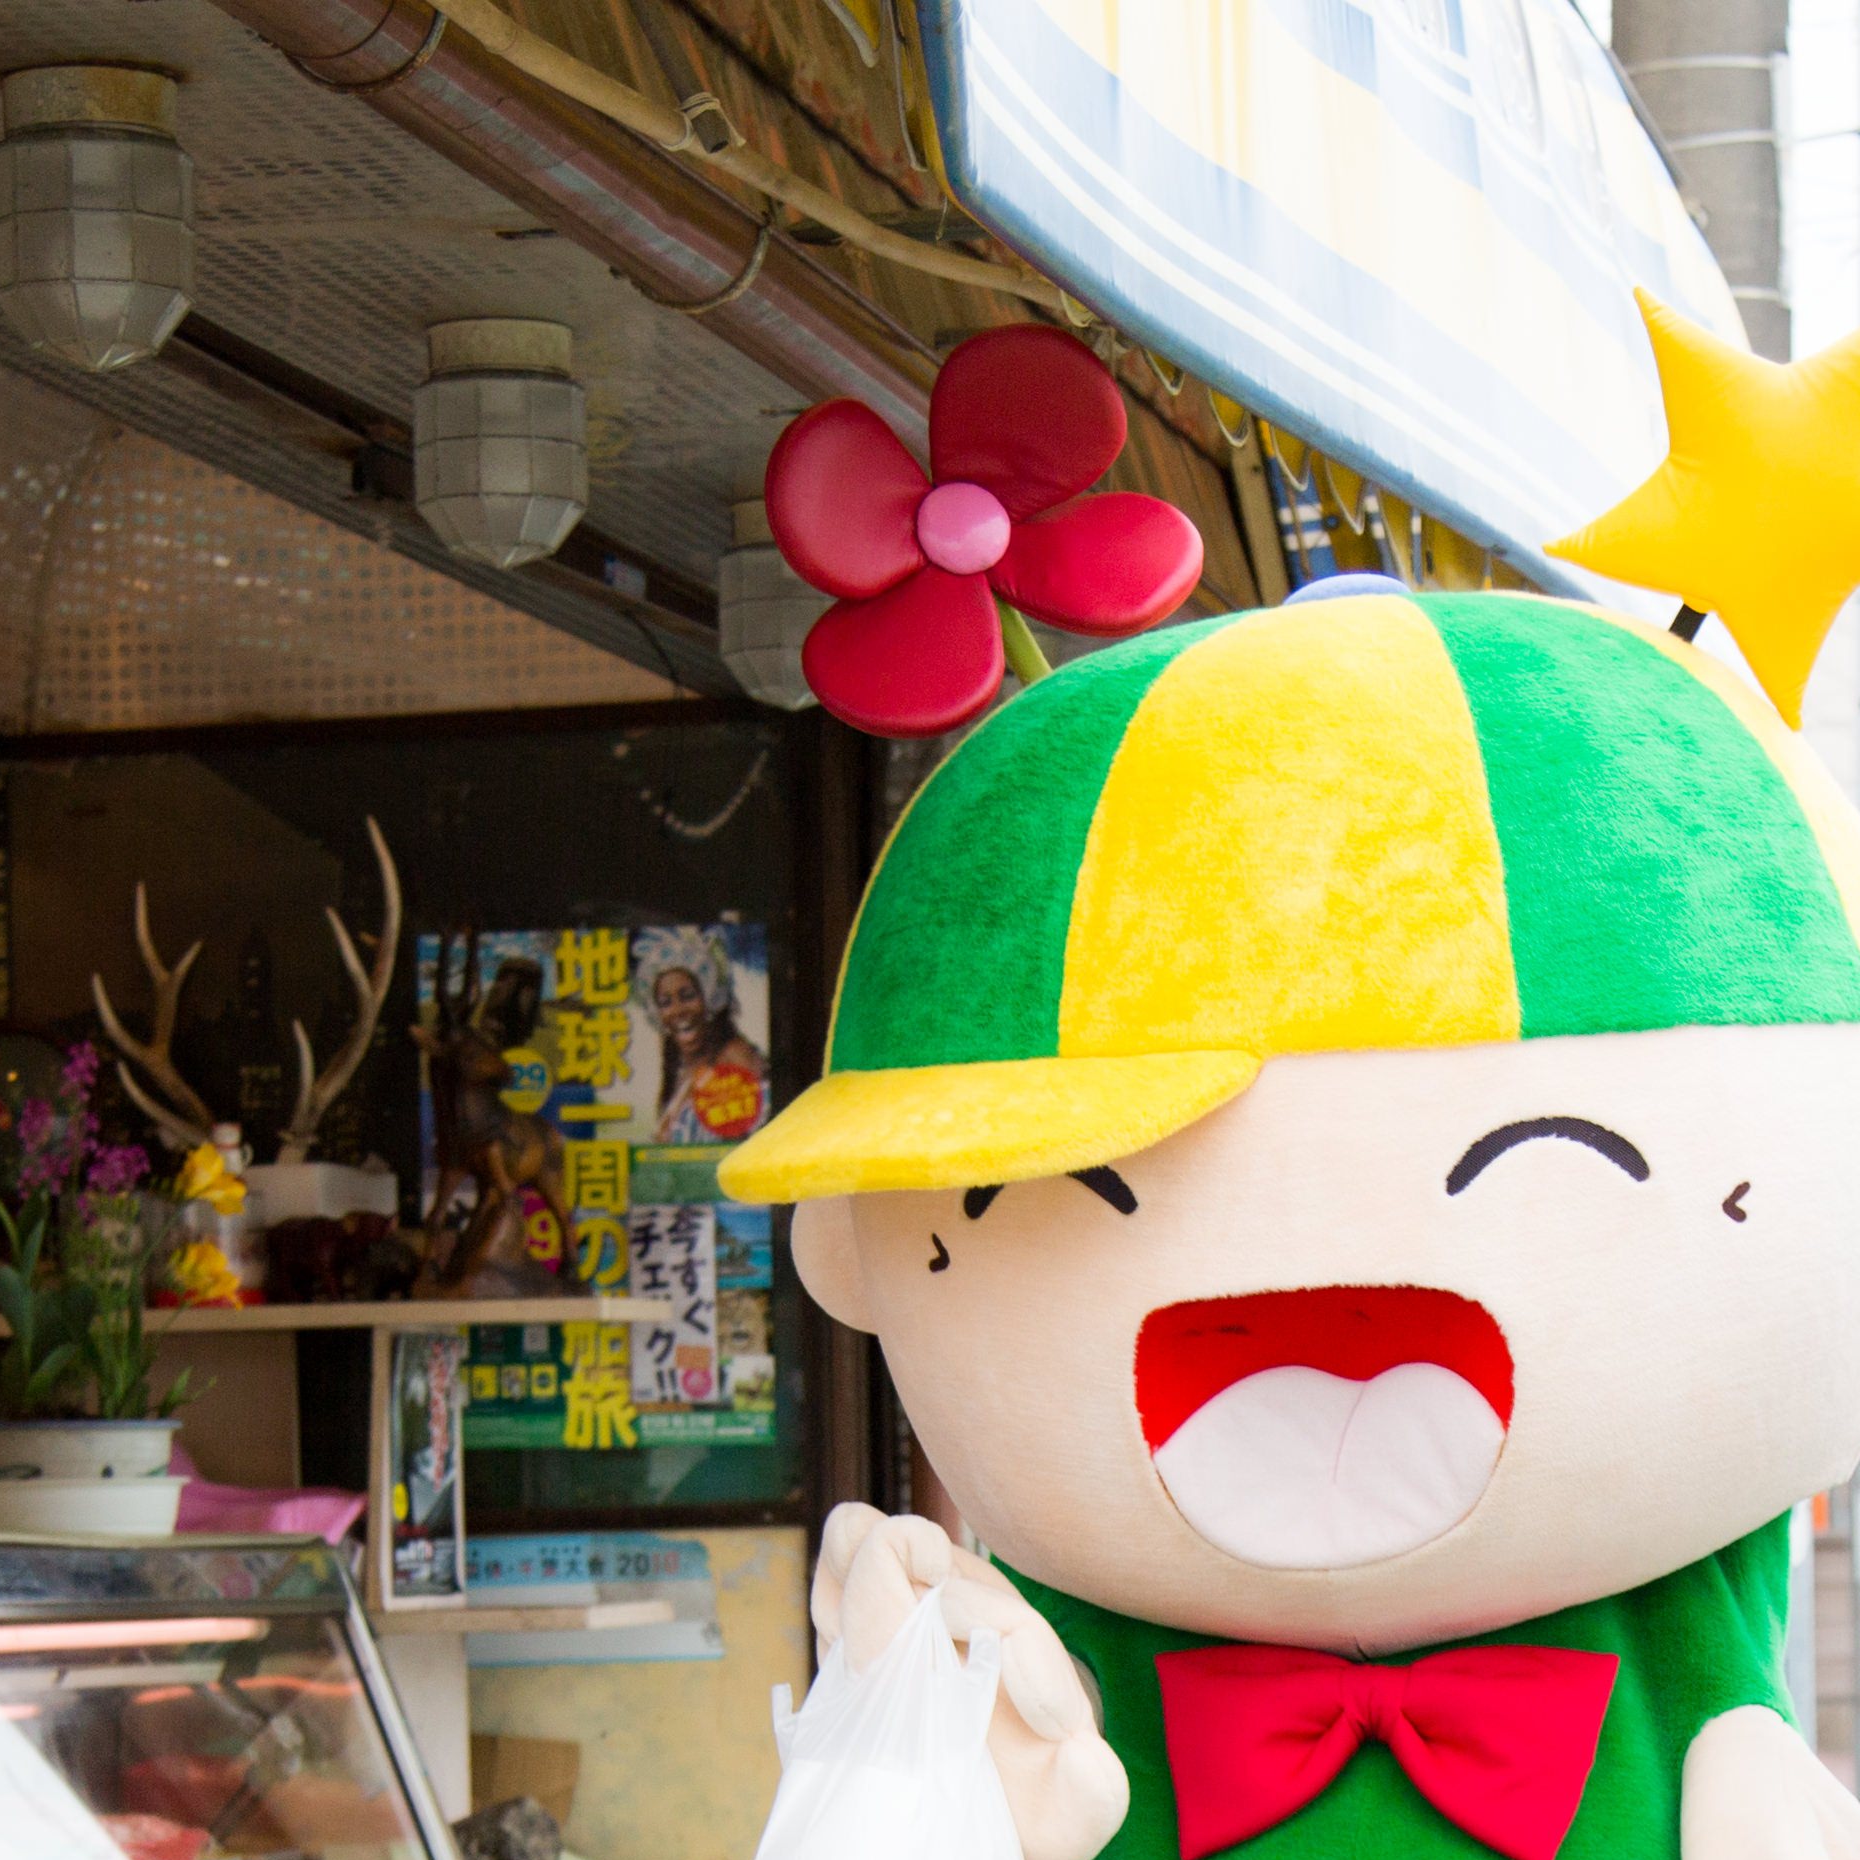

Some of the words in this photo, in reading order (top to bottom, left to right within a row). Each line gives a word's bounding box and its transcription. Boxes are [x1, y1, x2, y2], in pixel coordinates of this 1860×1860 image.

[554, 928, 639, 1448] 地球一周の船旅
[668, 1204, 715, 1335] 今すぐ
